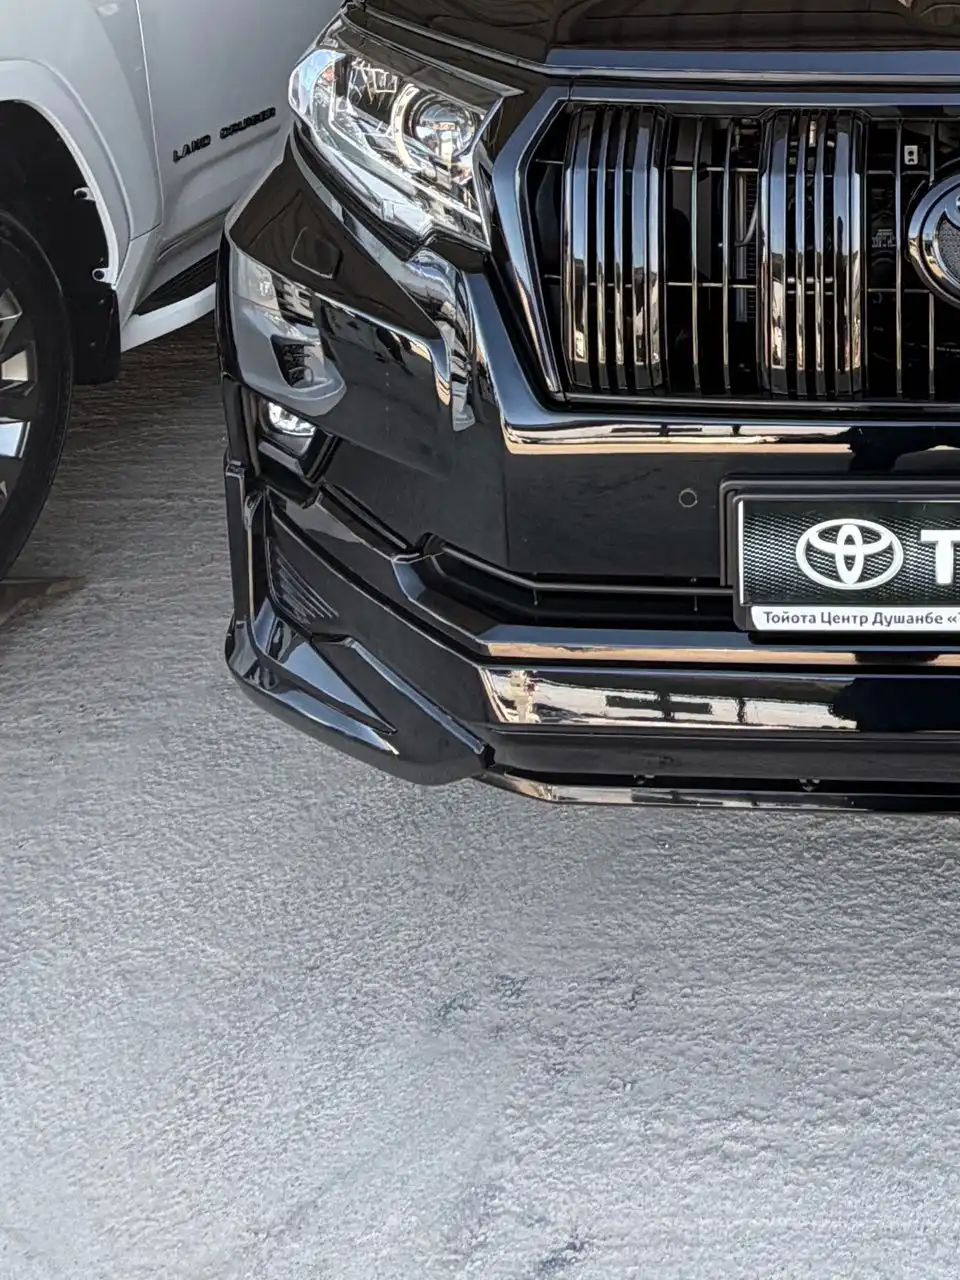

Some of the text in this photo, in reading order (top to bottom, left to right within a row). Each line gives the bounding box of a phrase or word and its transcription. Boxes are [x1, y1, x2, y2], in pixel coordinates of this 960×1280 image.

[763, 610, 817, 625] Тойота
[820, 611, 869, 627] Центр
[871, 611, 943, 628] Душанбе
